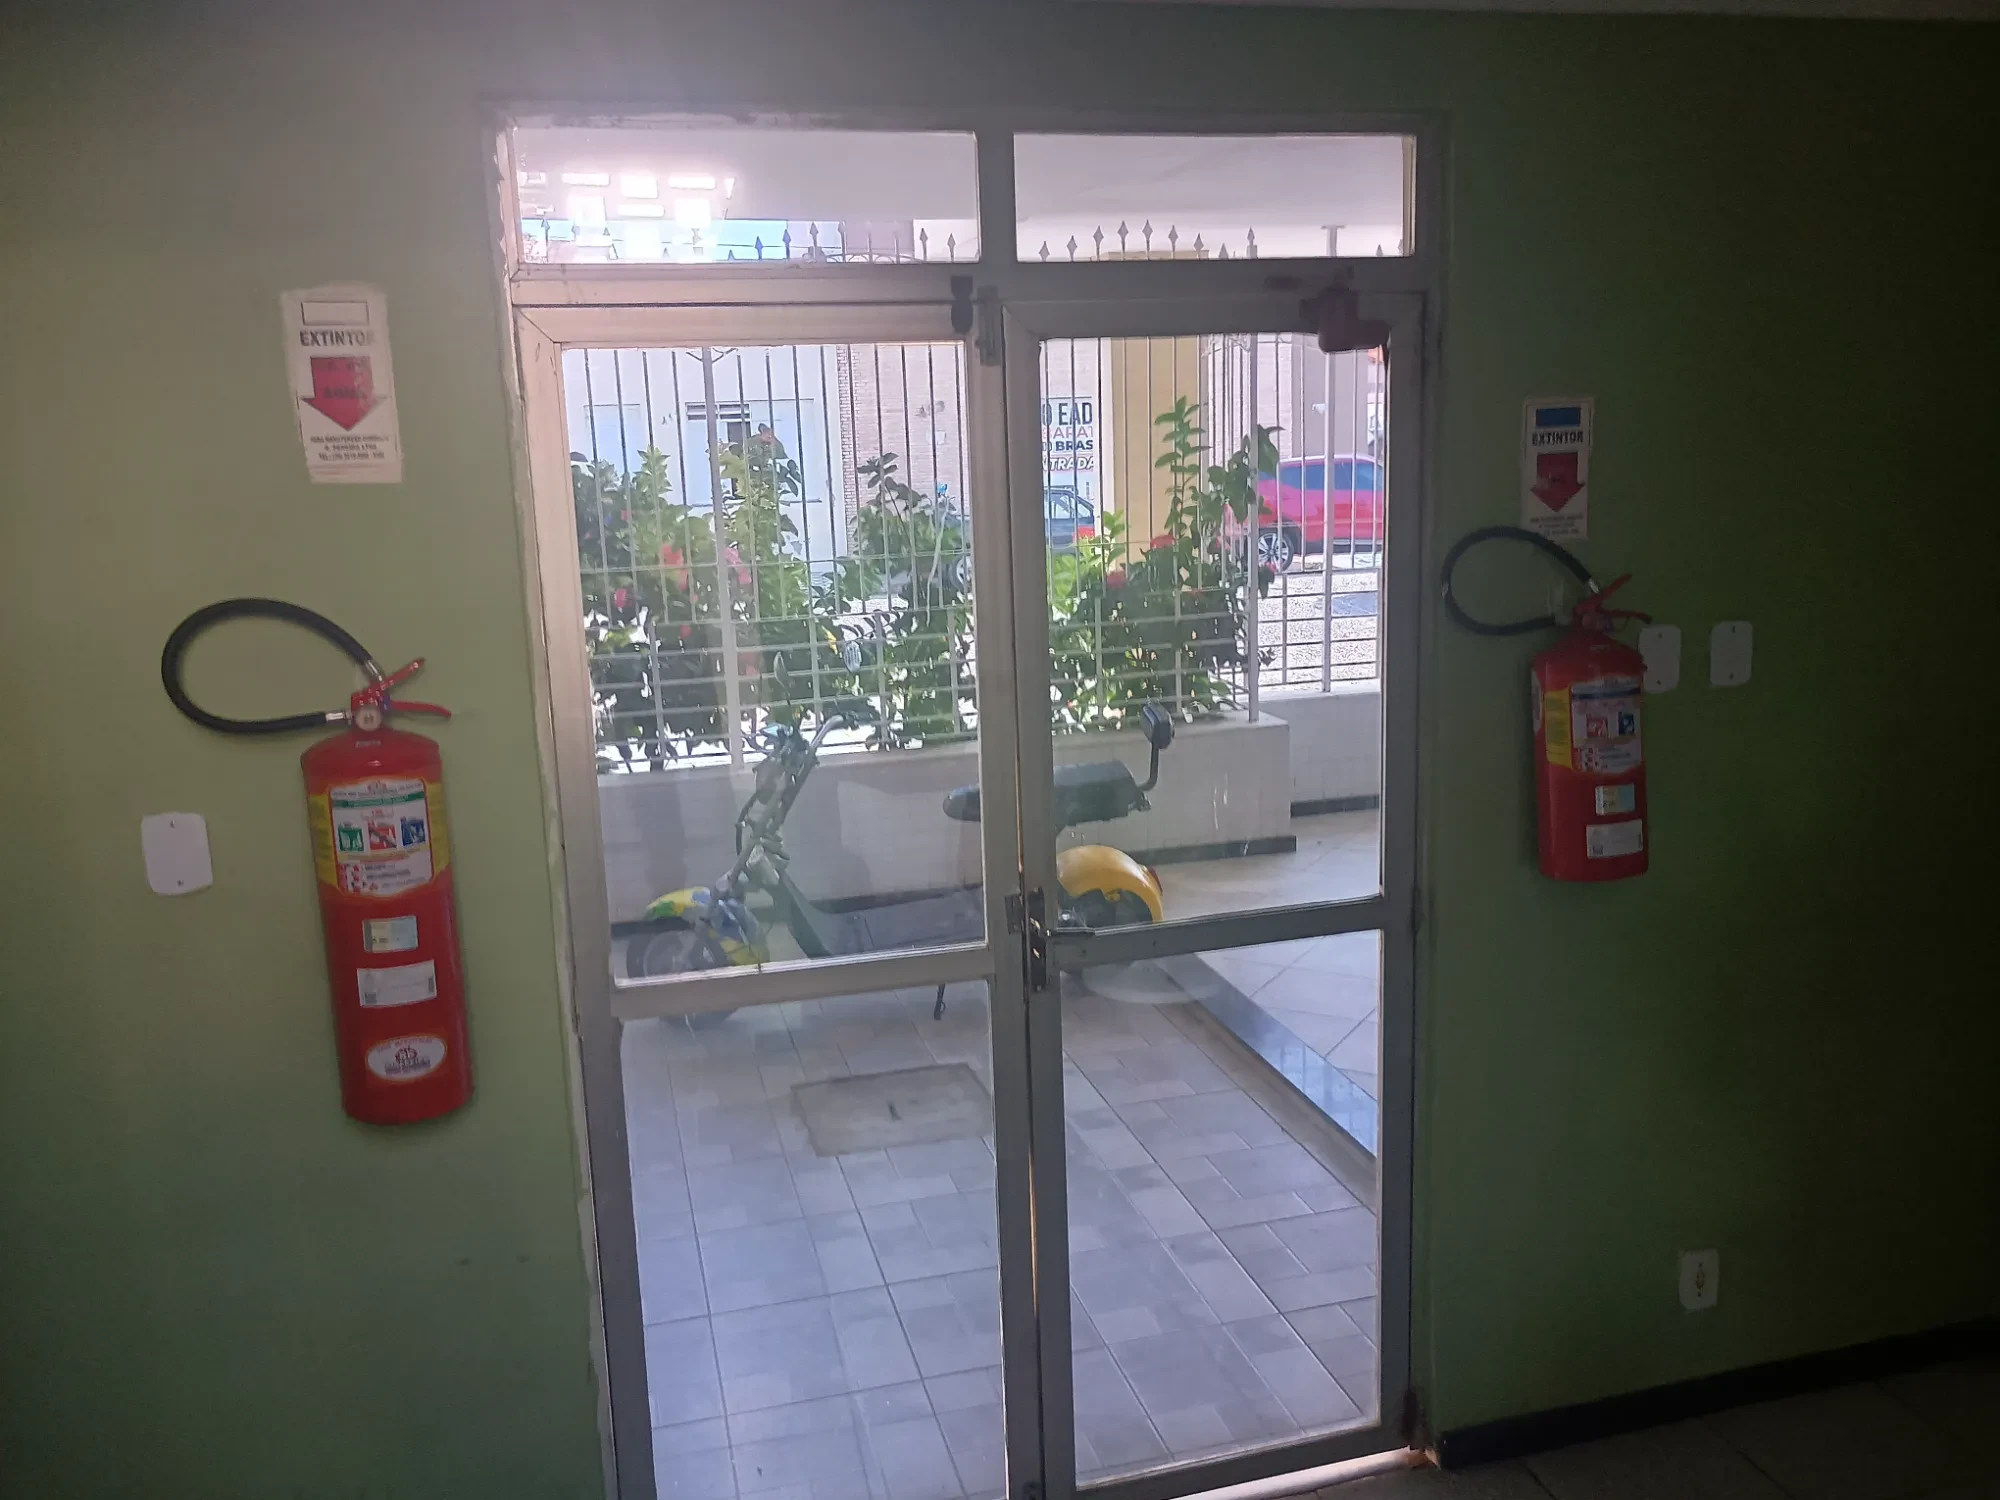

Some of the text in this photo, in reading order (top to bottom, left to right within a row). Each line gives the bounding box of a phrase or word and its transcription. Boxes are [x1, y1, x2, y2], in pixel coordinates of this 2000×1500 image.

[1058, 402, 1092, 426] EAD
[1055, 439, 1094, 452] BRAS
[1532, 430, 1583, 447] EXTINTOR
